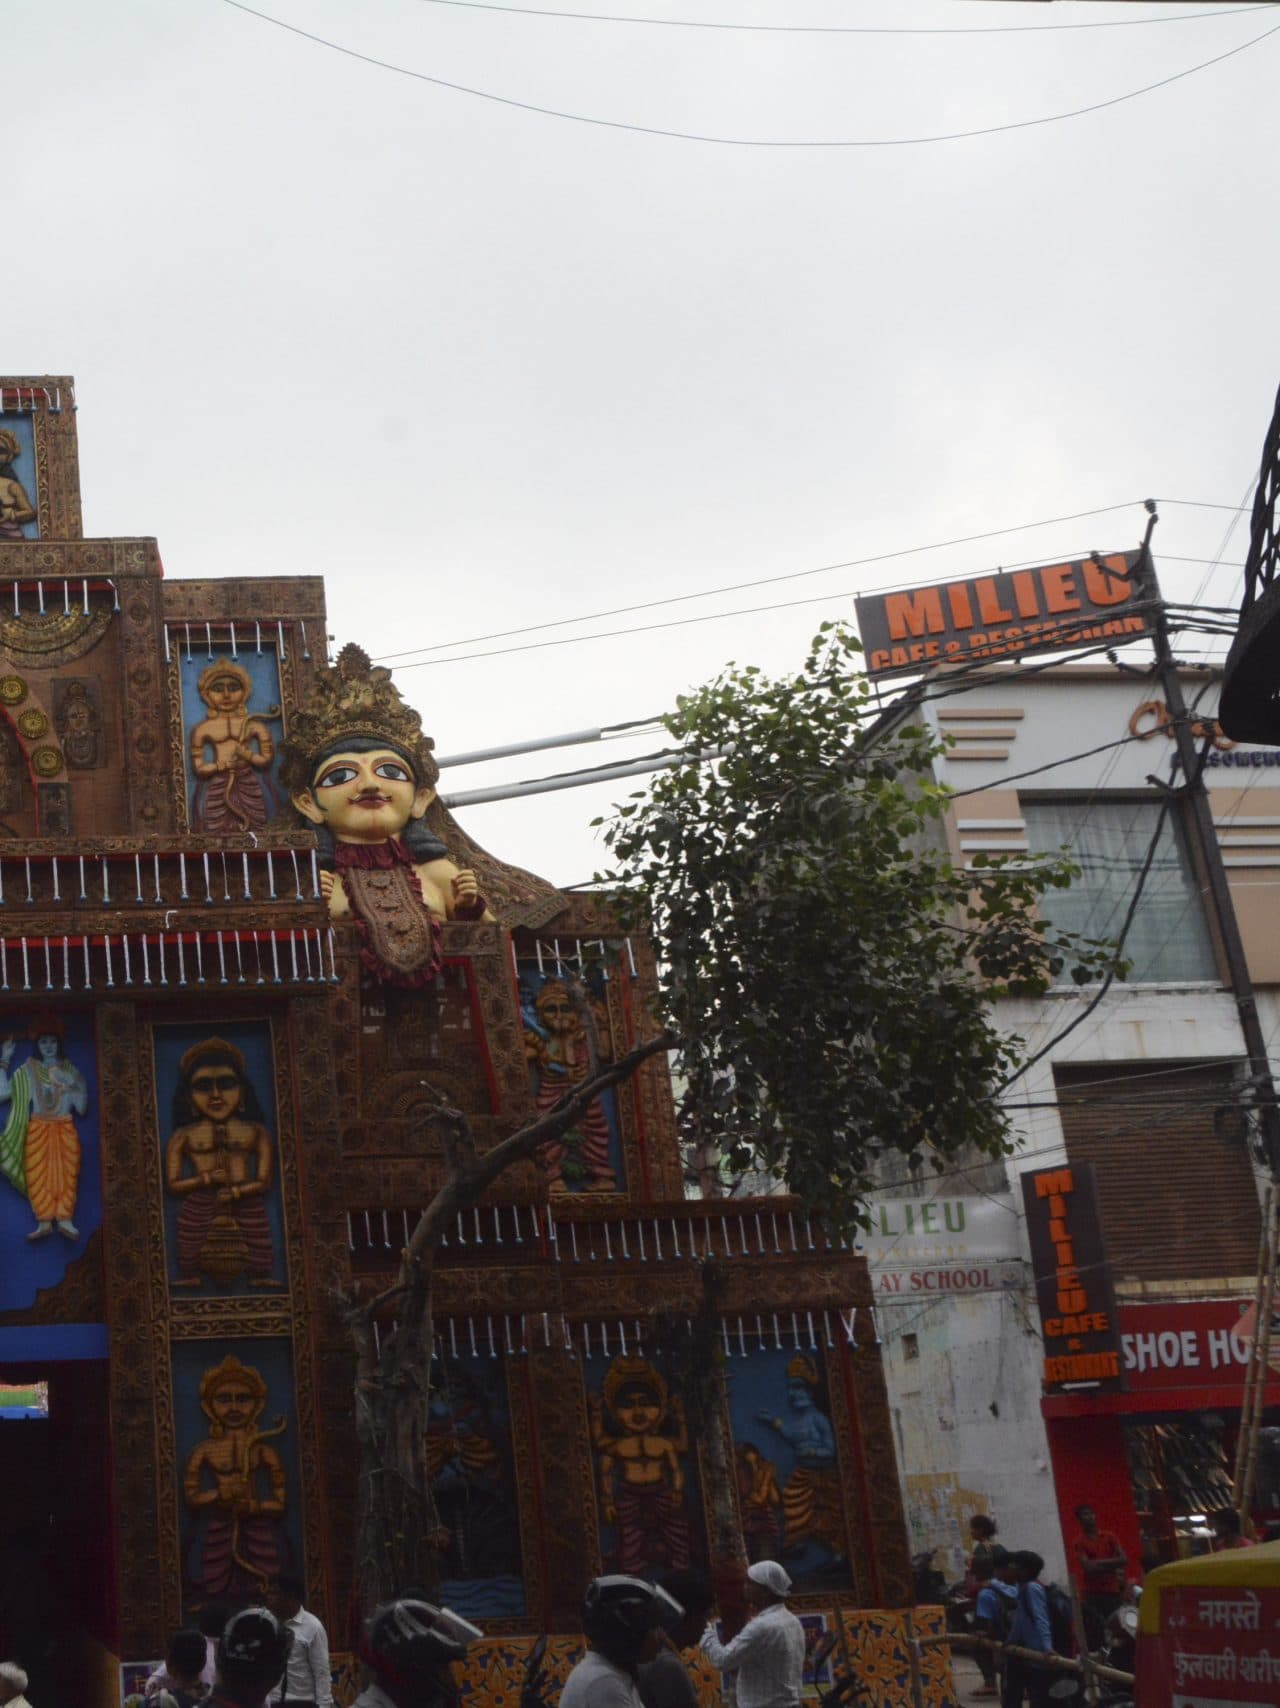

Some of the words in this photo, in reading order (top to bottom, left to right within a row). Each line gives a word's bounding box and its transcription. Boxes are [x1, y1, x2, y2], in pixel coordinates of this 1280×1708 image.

[885, 554, 1132, 640] MILIEU
[871, 641, 940, 670] CAFE
[1034, 1169, 1087, 1314] MILIEU
[910, 1268, 994, 1291] SCHOOL
[1044, 1312, 1109, 1337] CAFE
[1121, 1331, 1200, 1373] SHOE
[1198, 1589, 1261, 1630] नमस्ते
